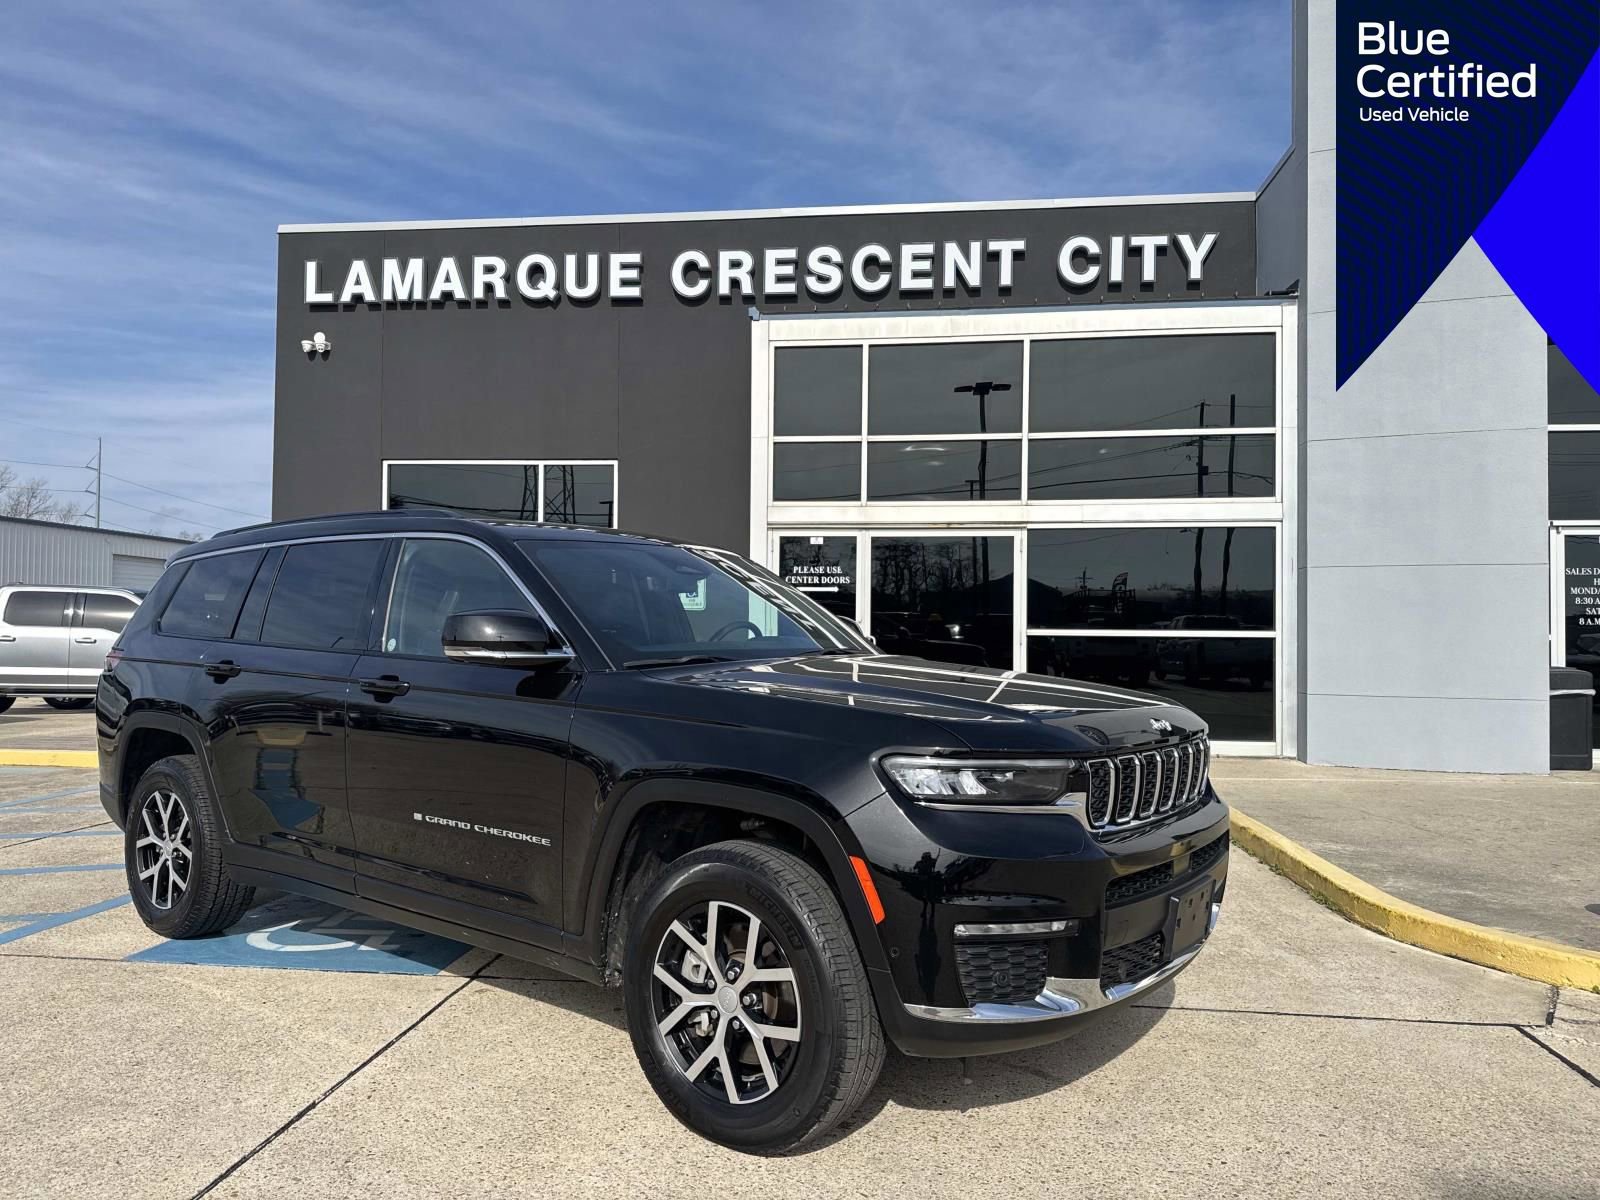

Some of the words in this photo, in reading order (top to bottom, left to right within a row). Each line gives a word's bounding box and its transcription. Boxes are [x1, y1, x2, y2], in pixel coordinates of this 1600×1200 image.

[303, 252, 643, 303] LAMARQUE
[670, 238, 1027, 299] CRESCENT
[1056, 231, 1219, 285] CITY
[793, 565, 825, 574] PLEASE
[826, 565, 843, 574] USE
[1565, 567, 1592, 576] SALES
[785, 575, 819, 584] CENTER
[821, 575, 850, 584] DOORS
[1575, 597, 1593, 605] 8:30
[1578, 617, 1585, 625] 8
[425, 815, 471, 830] GRAND
[474, 825, 552, 846] CHEROKEE
